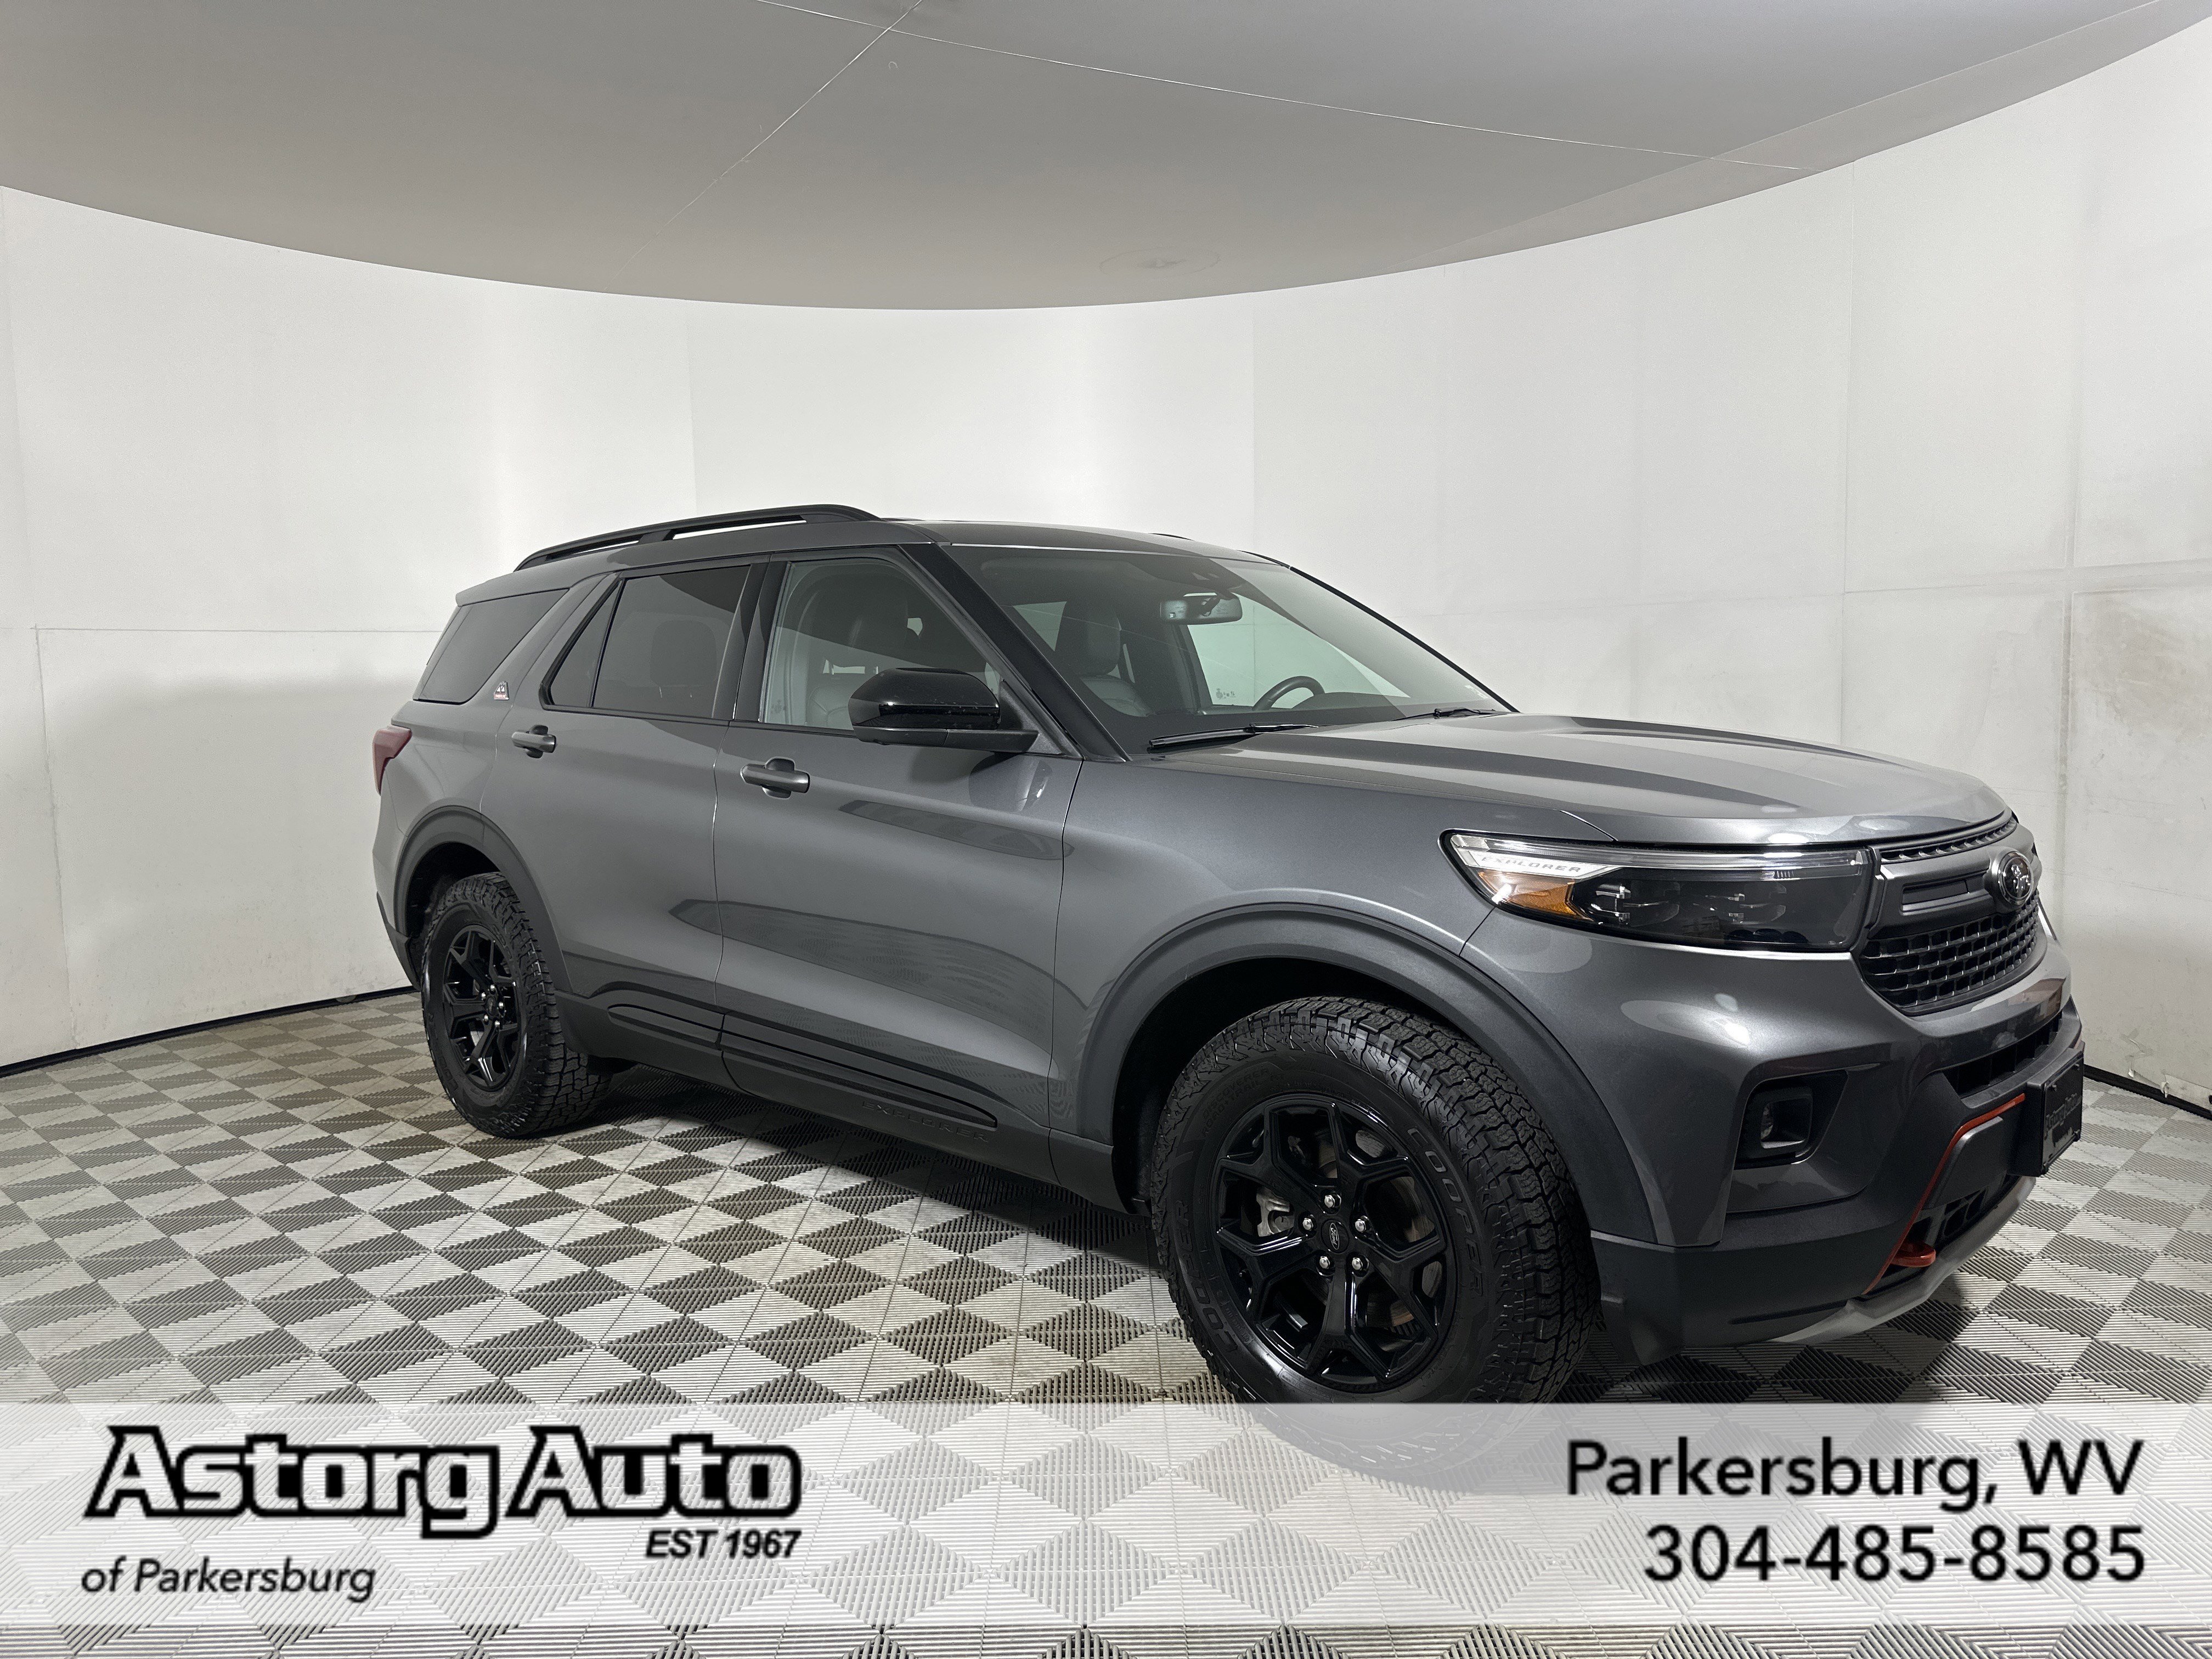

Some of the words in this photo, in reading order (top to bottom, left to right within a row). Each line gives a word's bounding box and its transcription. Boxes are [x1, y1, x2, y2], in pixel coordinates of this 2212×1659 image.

[1481, 856, 1582, 873] EXPLORER
[862, 1101, 990, 1143] EXPLORER
[1407, 1127, 1483, 1297] COOPER
